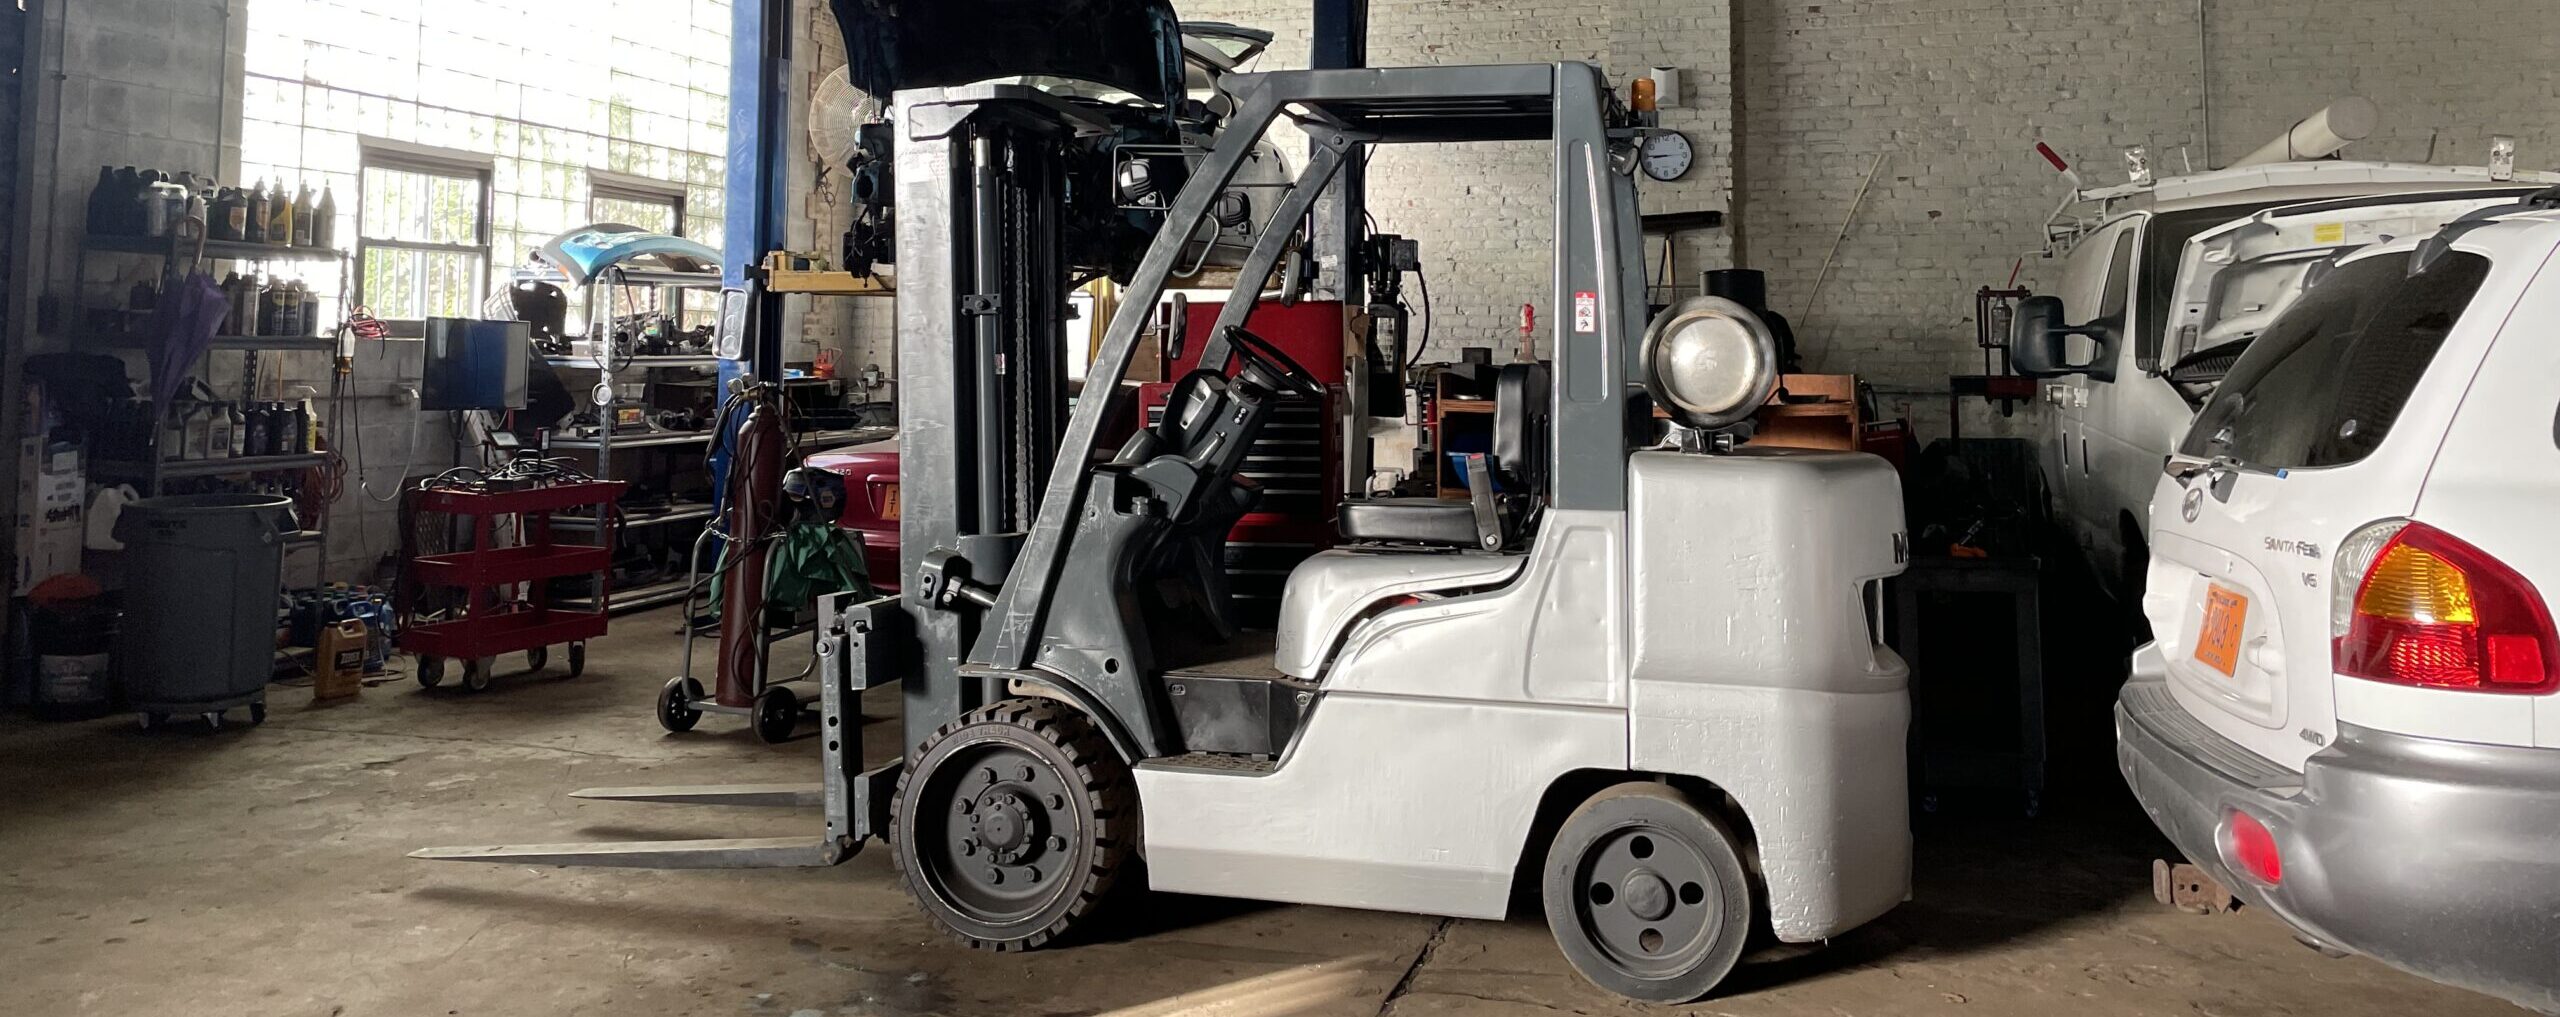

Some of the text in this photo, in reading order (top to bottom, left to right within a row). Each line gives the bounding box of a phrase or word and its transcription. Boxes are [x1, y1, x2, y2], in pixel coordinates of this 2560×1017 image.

[2264, 536, 2295, 553] SANTA
[2302, 572, 2317, 588] V6
[2299, 728, 2326, 747] 4WD
